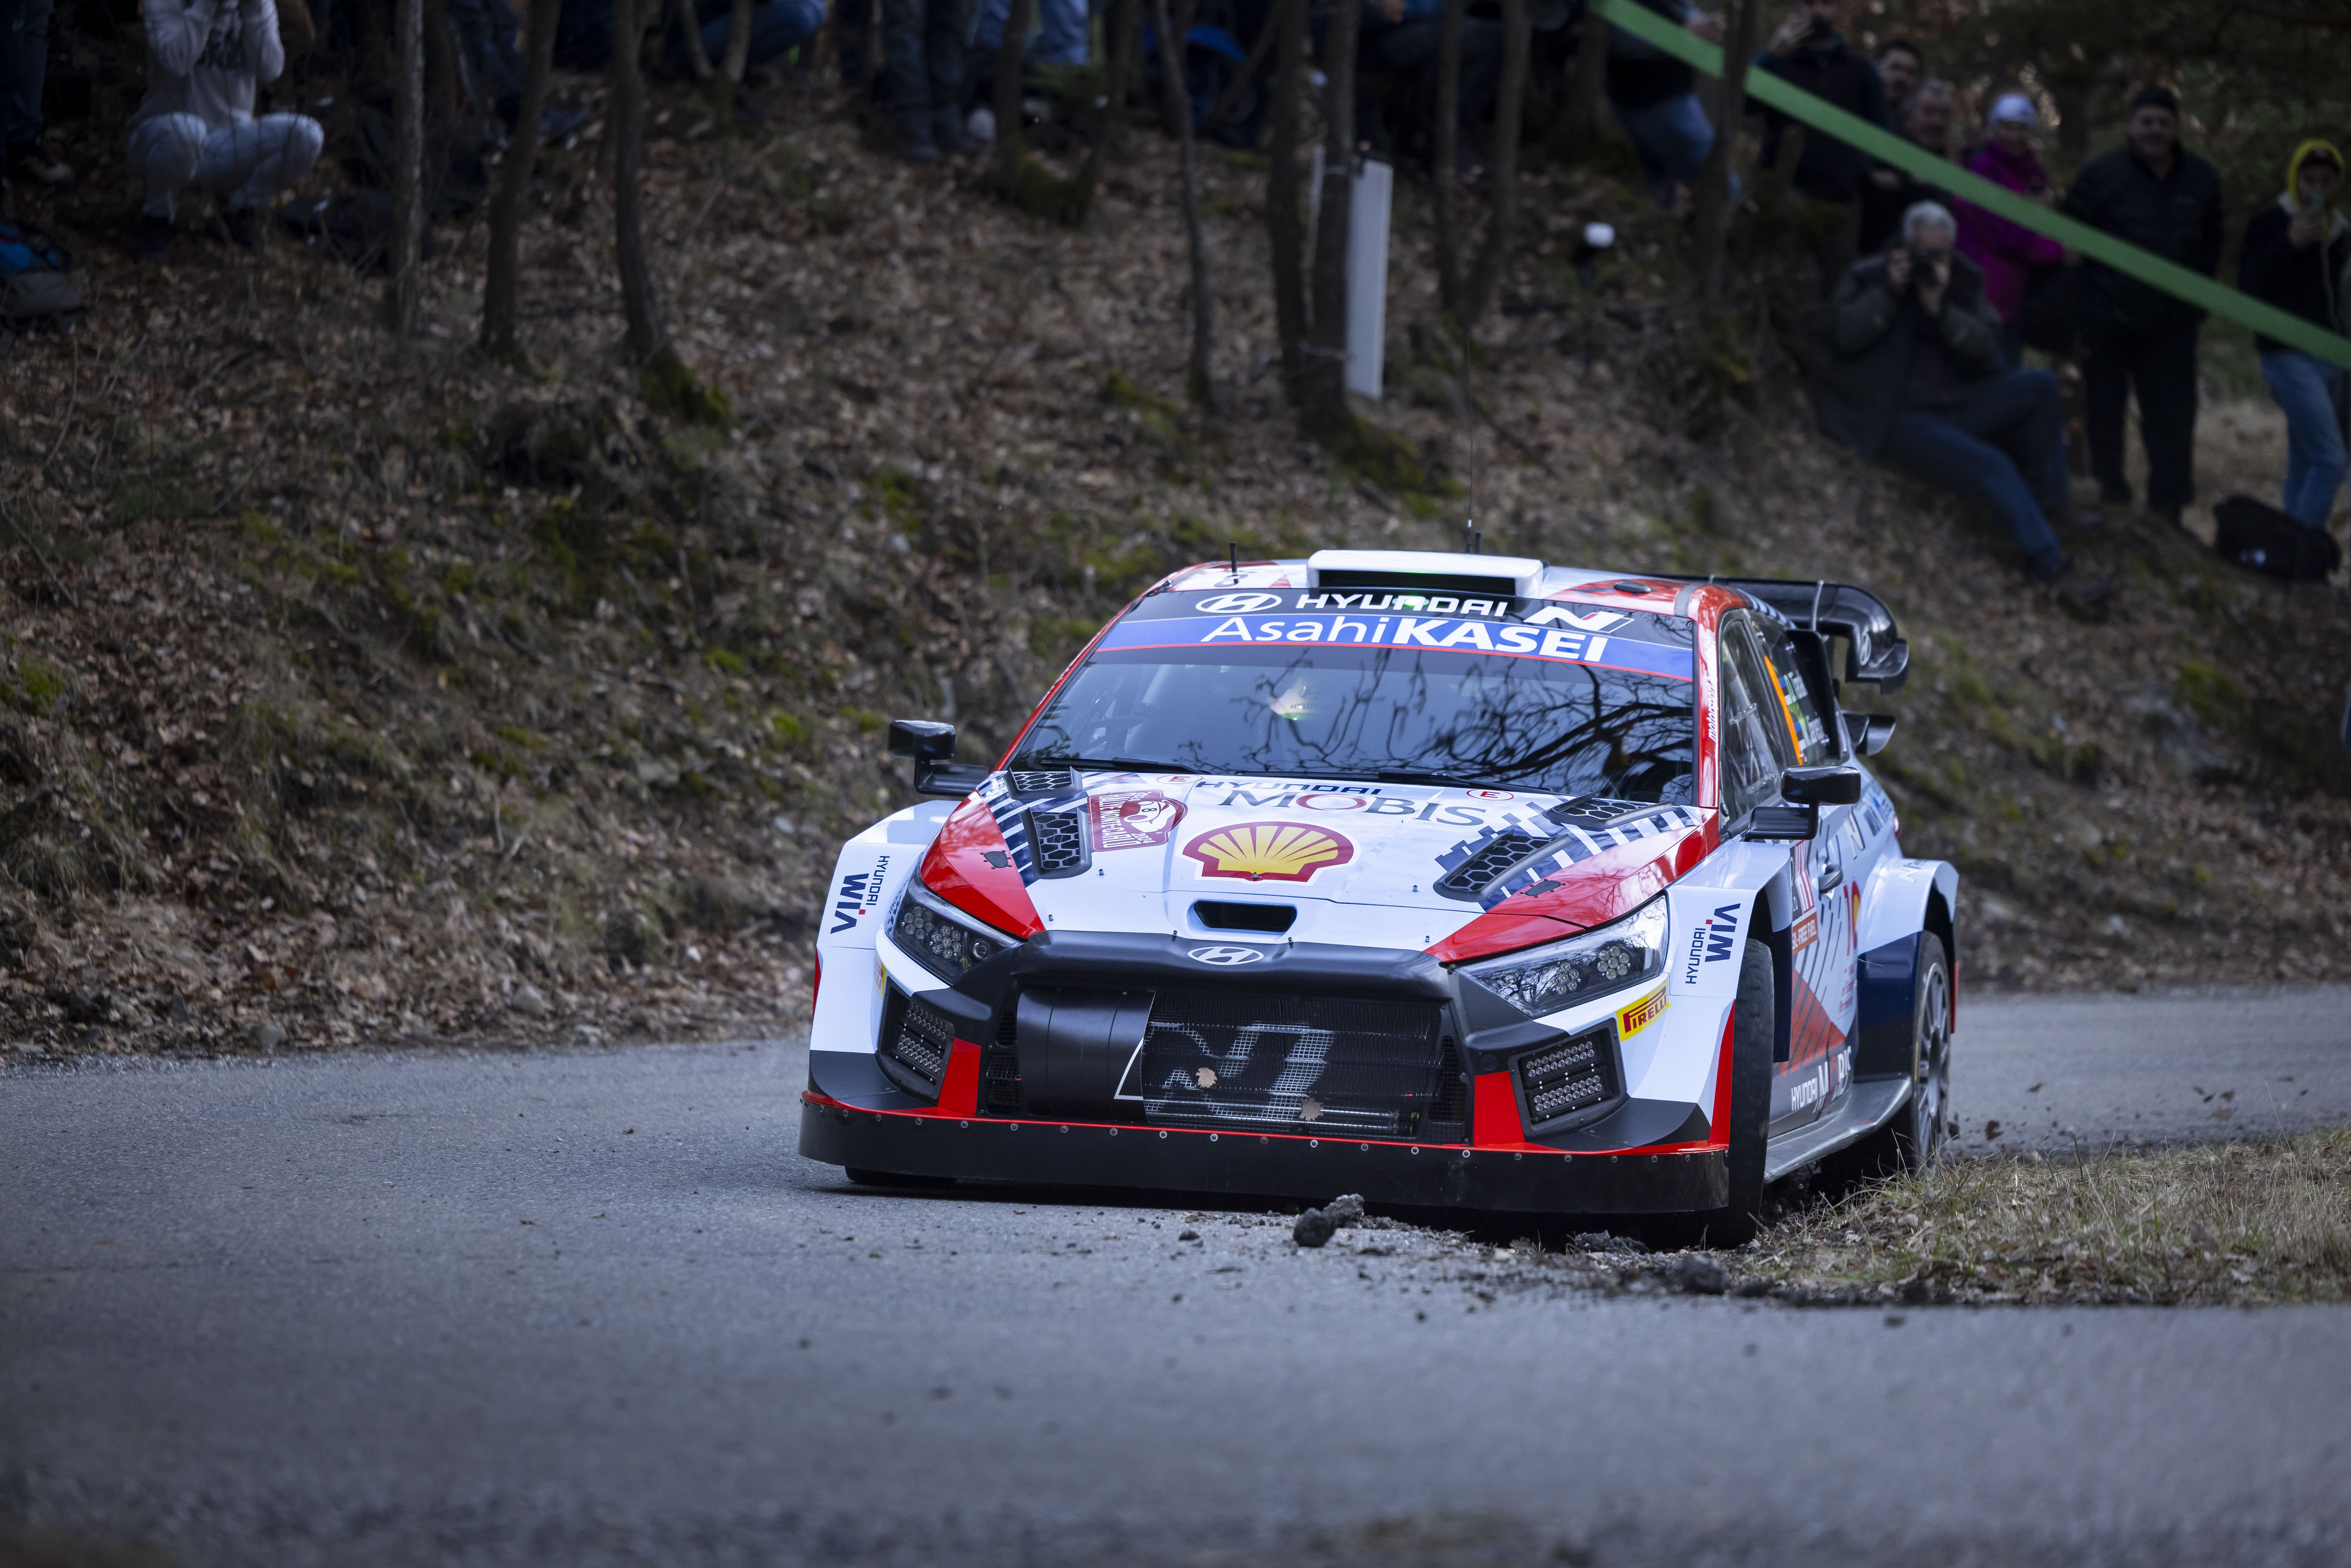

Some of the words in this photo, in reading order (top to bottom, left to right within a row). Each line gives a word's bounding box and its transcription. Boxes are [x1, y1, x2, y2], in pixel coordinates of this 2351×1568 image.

[1295, 594, 1508, 616] HYUNDAI
[1200, 616, 1609, 662] AsahiKASEI
[1099, 792, 1139, 810] RALLYE
[1195, 781, 1382, 795] HYUNDAI
[1217, 790, 1487, 826] MOBIS
[1130, 832, 1156, 844] 2024
[866, 856, 890, 906] HYUNDAI
[1685, 928, 1706, 984] HYUNDAI
[1623, 985, 1666, 1033] PIRELLI
[1791, 1077, 1818, 1111] HYUNDAI
